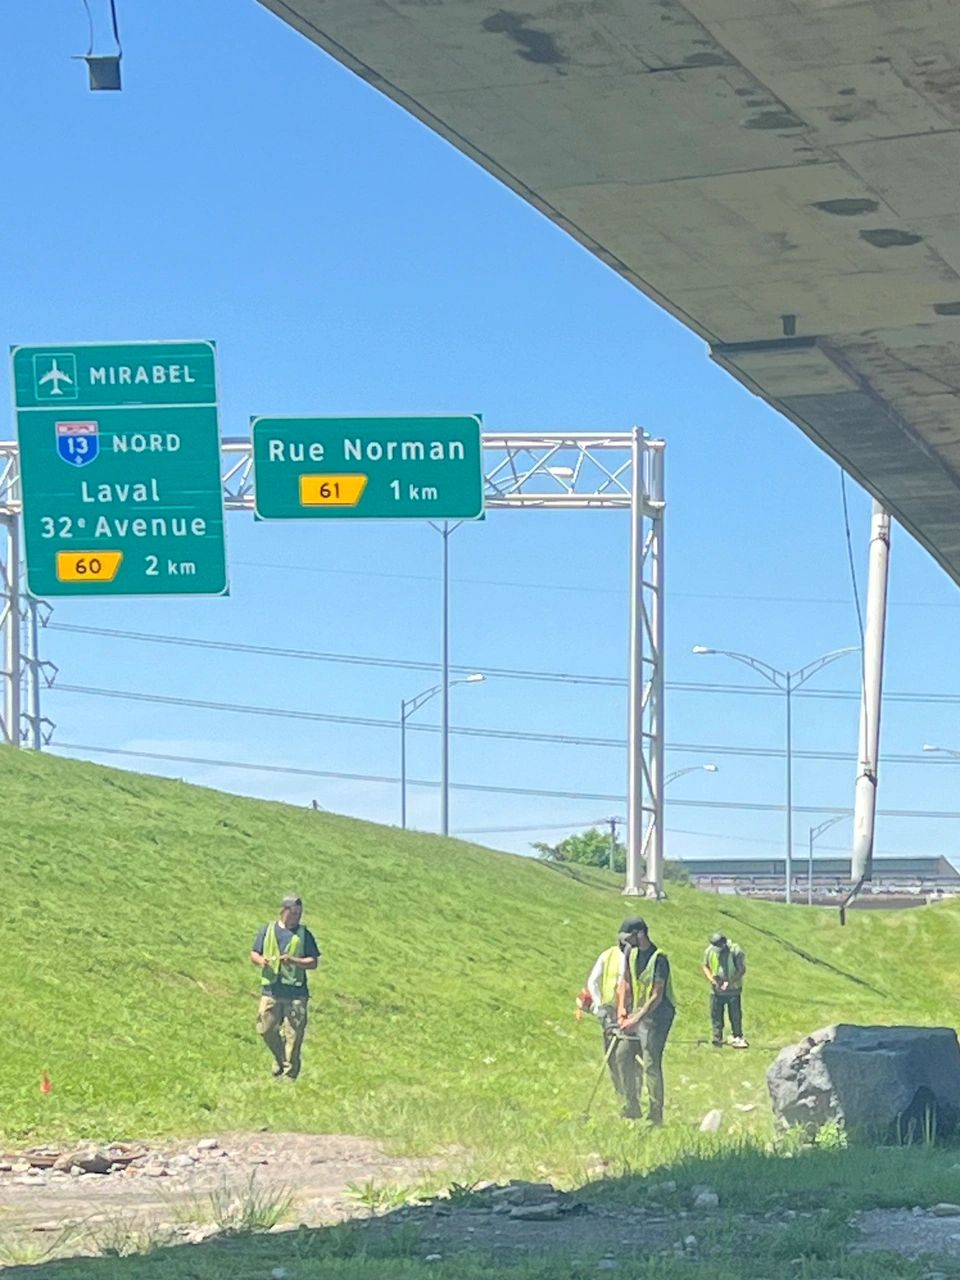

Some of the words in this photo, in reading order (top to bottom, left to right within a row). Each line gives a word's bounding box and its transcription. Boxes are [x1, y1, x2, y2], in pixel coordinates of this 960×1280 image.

[90, 365, 196, 385] MIRABEL
[67, 437, 88, 454] 13
[112, 434, 181, 453] NORD
[269, 439, 325, 461] Rue
[343, 438, 465, 461] Norman
[81, 478, 160, 502] Laval
[319, 482, 340, 498] 61
[390, 480, 401, 500] 1
[409, 484, 438, 500] km
[94, 516, 207, 538] Avenue
[75, 558, 101, 574] 60
[145, 555, 159, 576] 2
[167, 559, 196, 575] km
